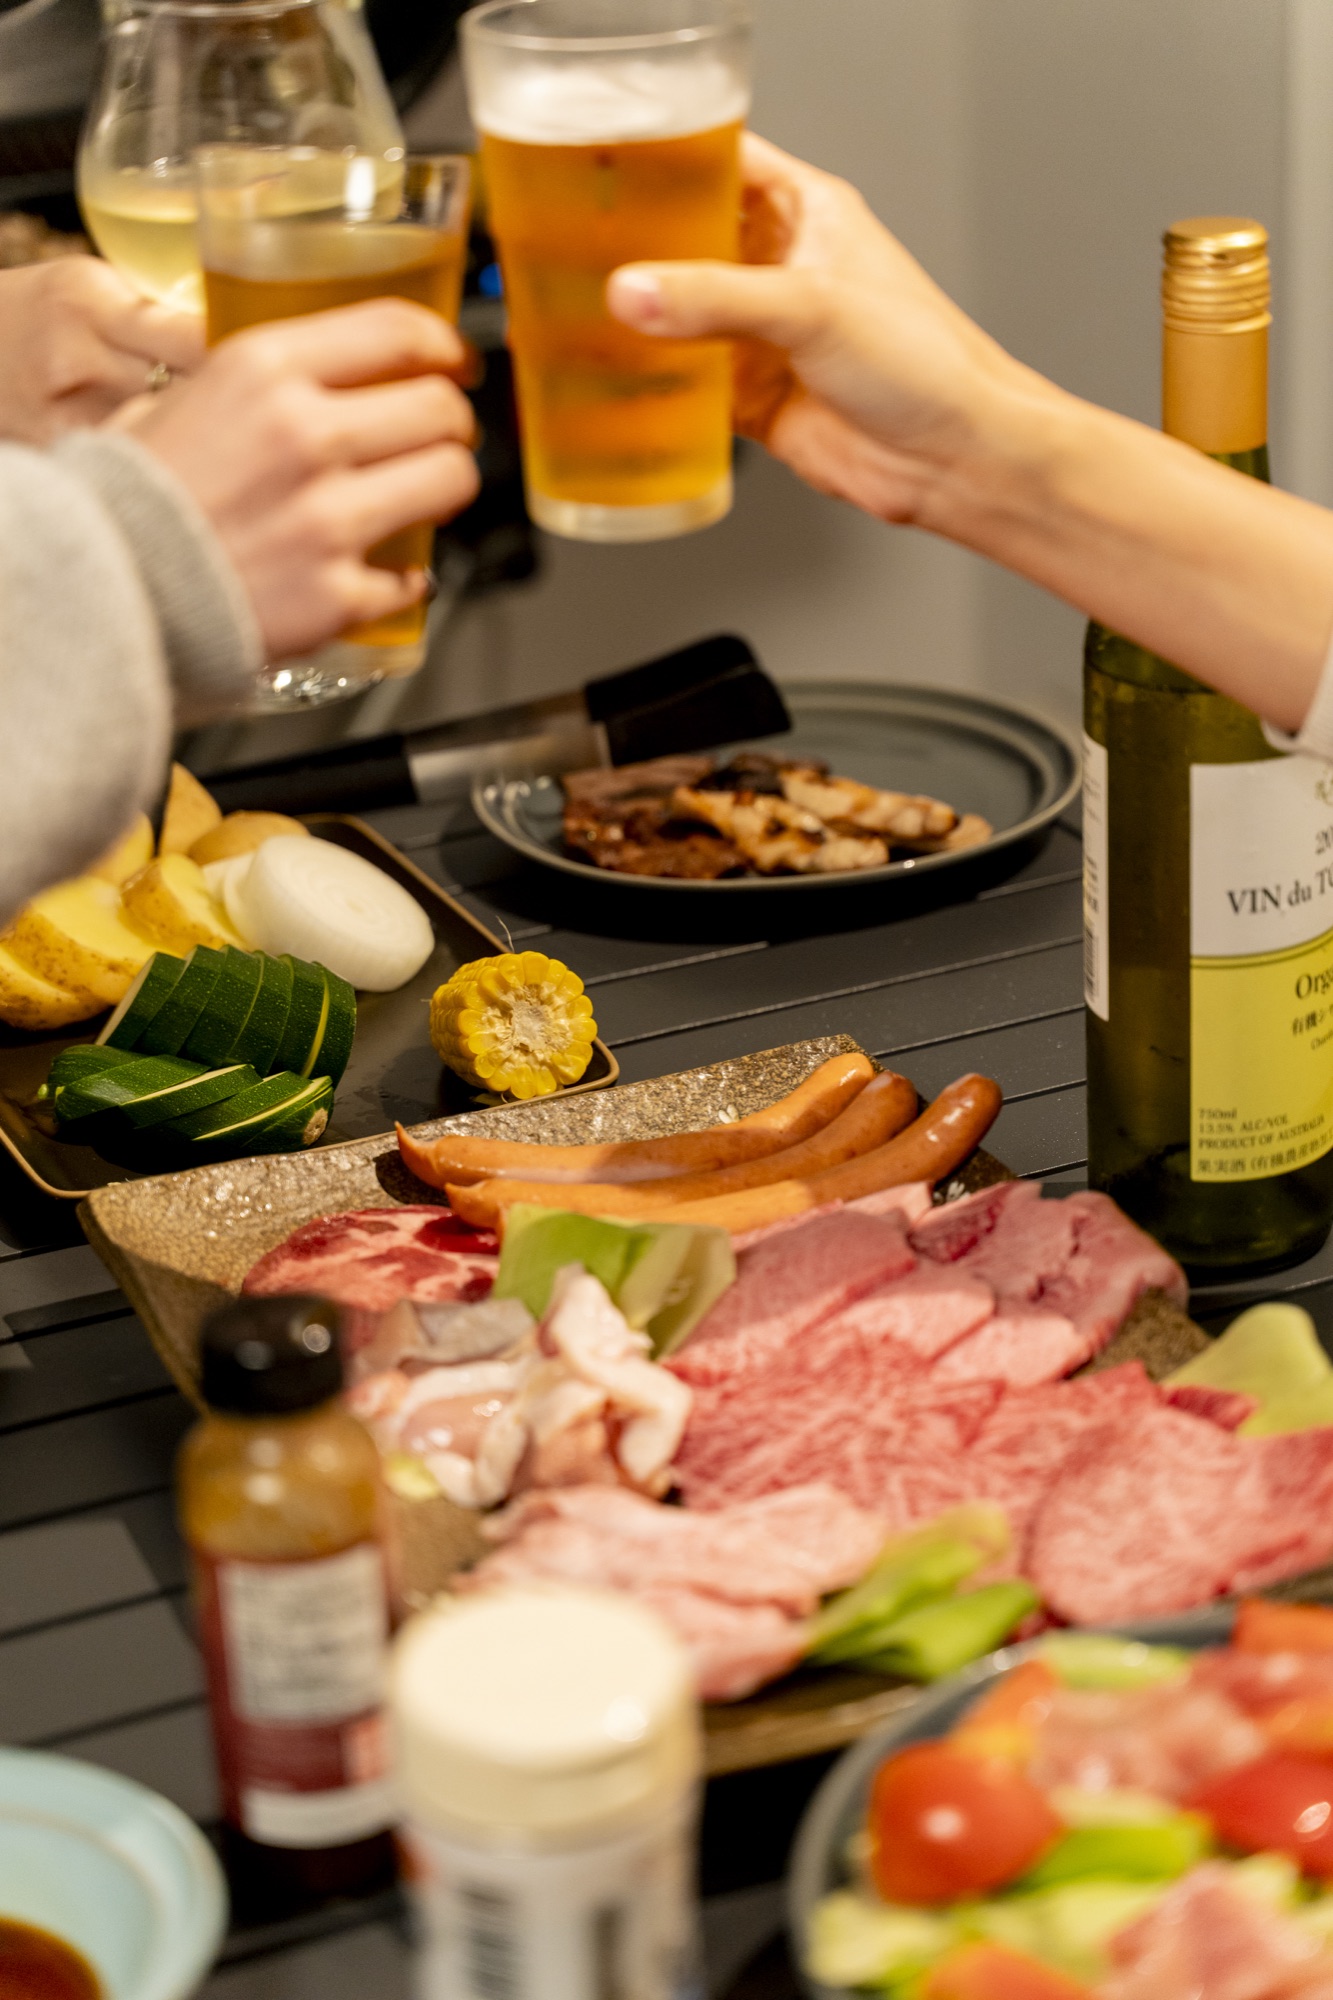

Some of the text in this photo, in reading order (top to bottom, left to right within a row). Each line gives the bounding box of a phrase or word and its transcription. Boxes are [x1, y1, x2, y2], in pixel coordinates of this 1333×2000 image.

[1227, 884, 1281, 914] VIN
[1288, 880, 1313, 906] du
[1198, 1136, 1256, 1150] PRODUCT
[1258, 1132, 1273, 1146] OF
